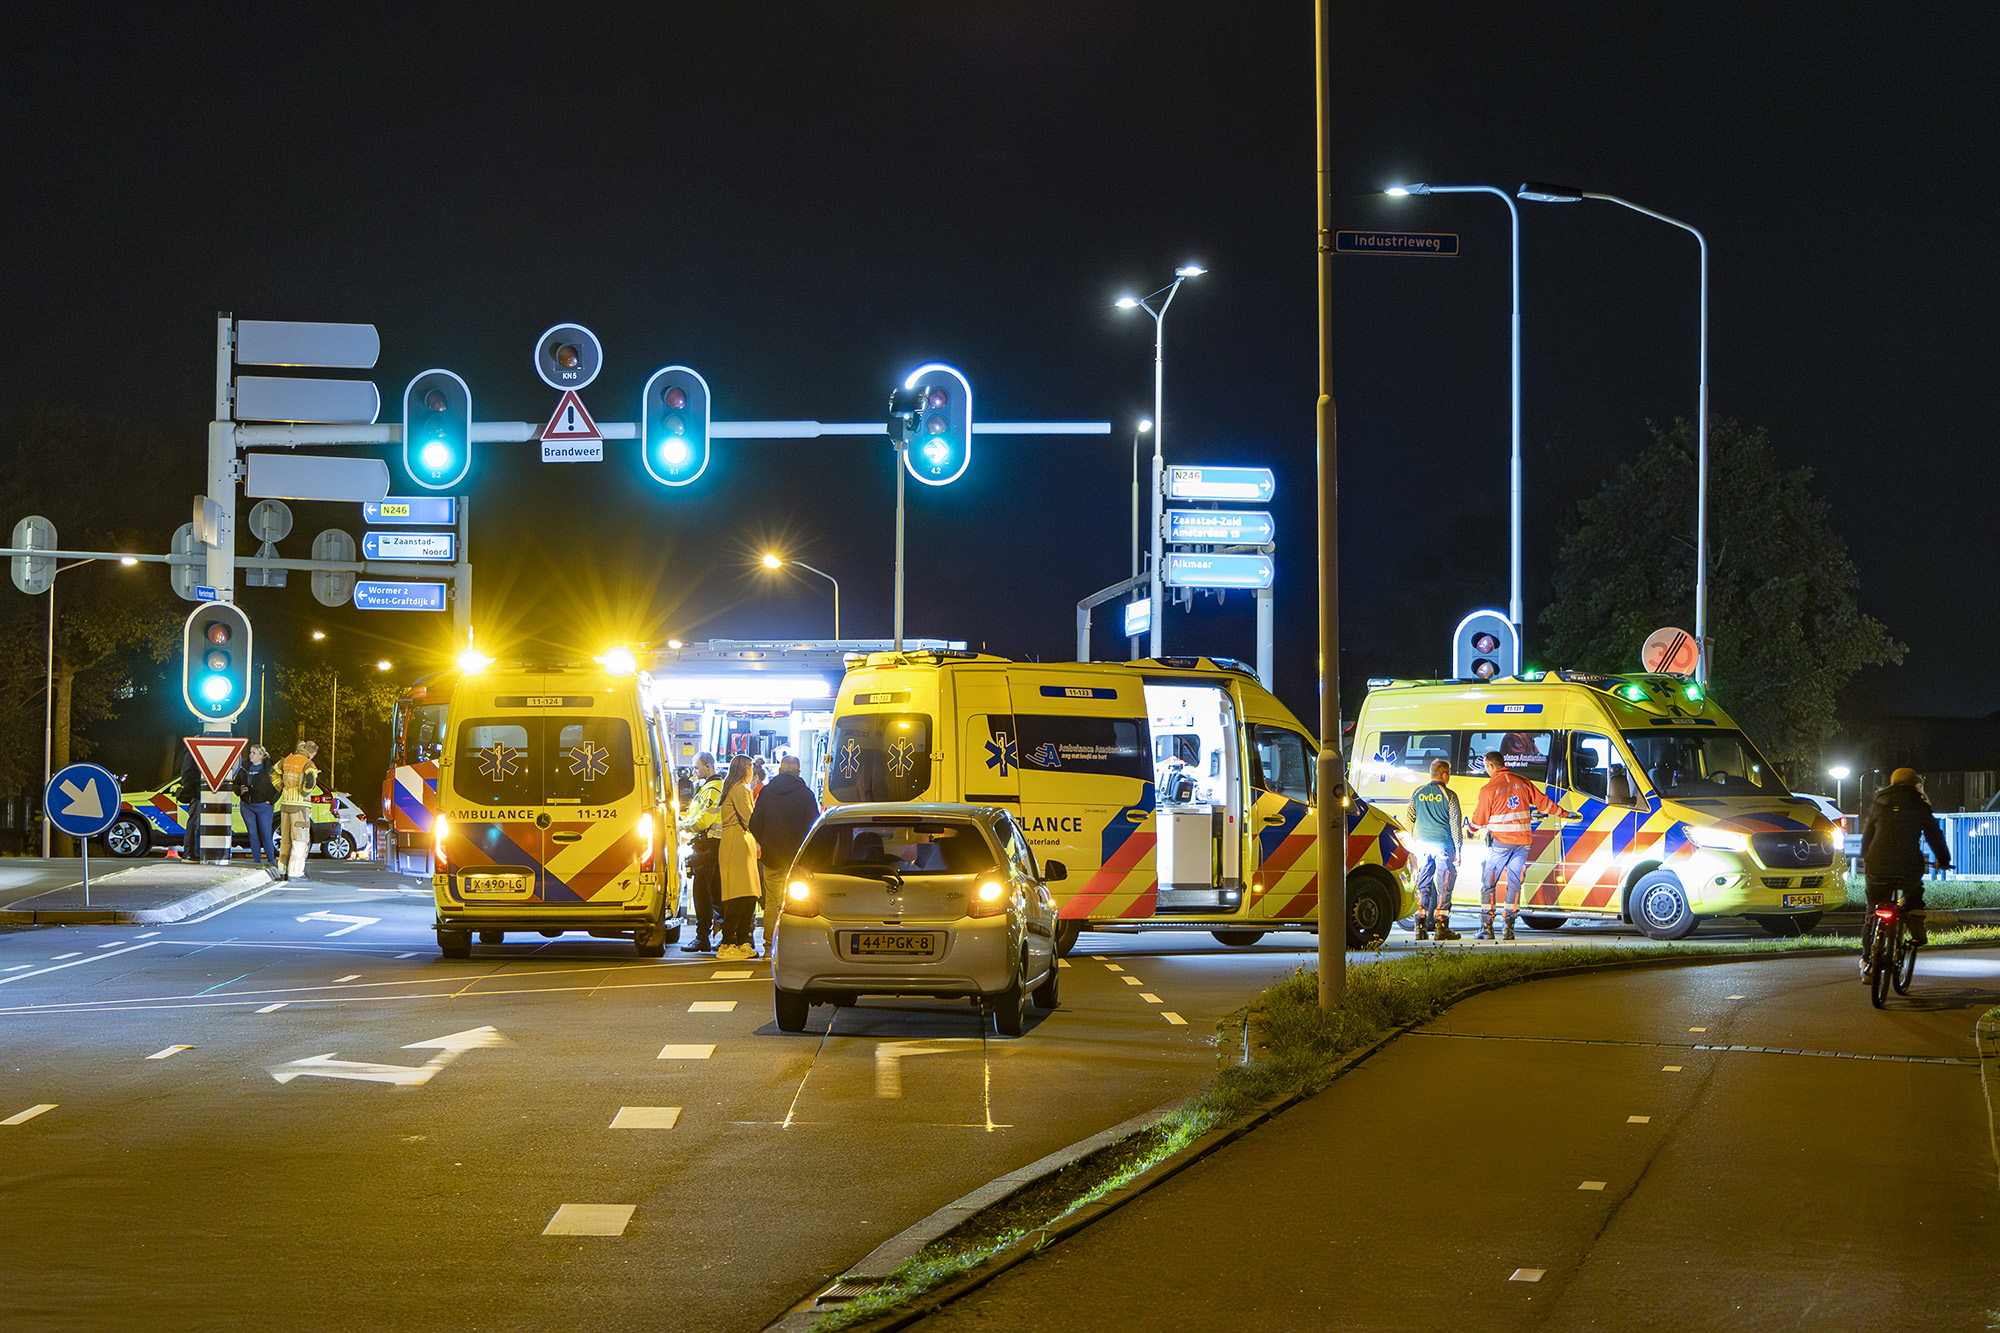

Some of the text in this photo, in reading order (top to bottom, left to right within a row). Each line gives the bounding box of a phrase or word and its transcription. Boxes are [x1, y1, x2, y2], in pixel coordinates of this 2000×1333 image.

[1354, 234, 1441, 251] Industrieweg
[543, 447, 601, 457] Brandweer
[930, 466, 941, 475] 4.2
[1175, 471, 1200, 480] N246
[383, 506, 407, 514] N246
[1172, 515, 1242, 526] Zaanstad-Zuid
[1172, 528, 1228, 539] Amsterdam
[393, 537, 435, 546] Zaanstad-
[422, 548, 448, 556] Noord
[1172, 559, 1213, 569] Alkmaar
[368, 586, 401, 595] Wormer
[368, 597, 428, 607] West-Graftdijk
[1648, 641, 1693, 669] 30
[1069, 689, 1090, 697] 11-133
[1418, 793, 1442, 802] OvD-G
[449, 809, 534, 819] AMBULANCE
[577, 809, 618, 819] 11-124
[474, 879, 522, 889] X-490-LG
